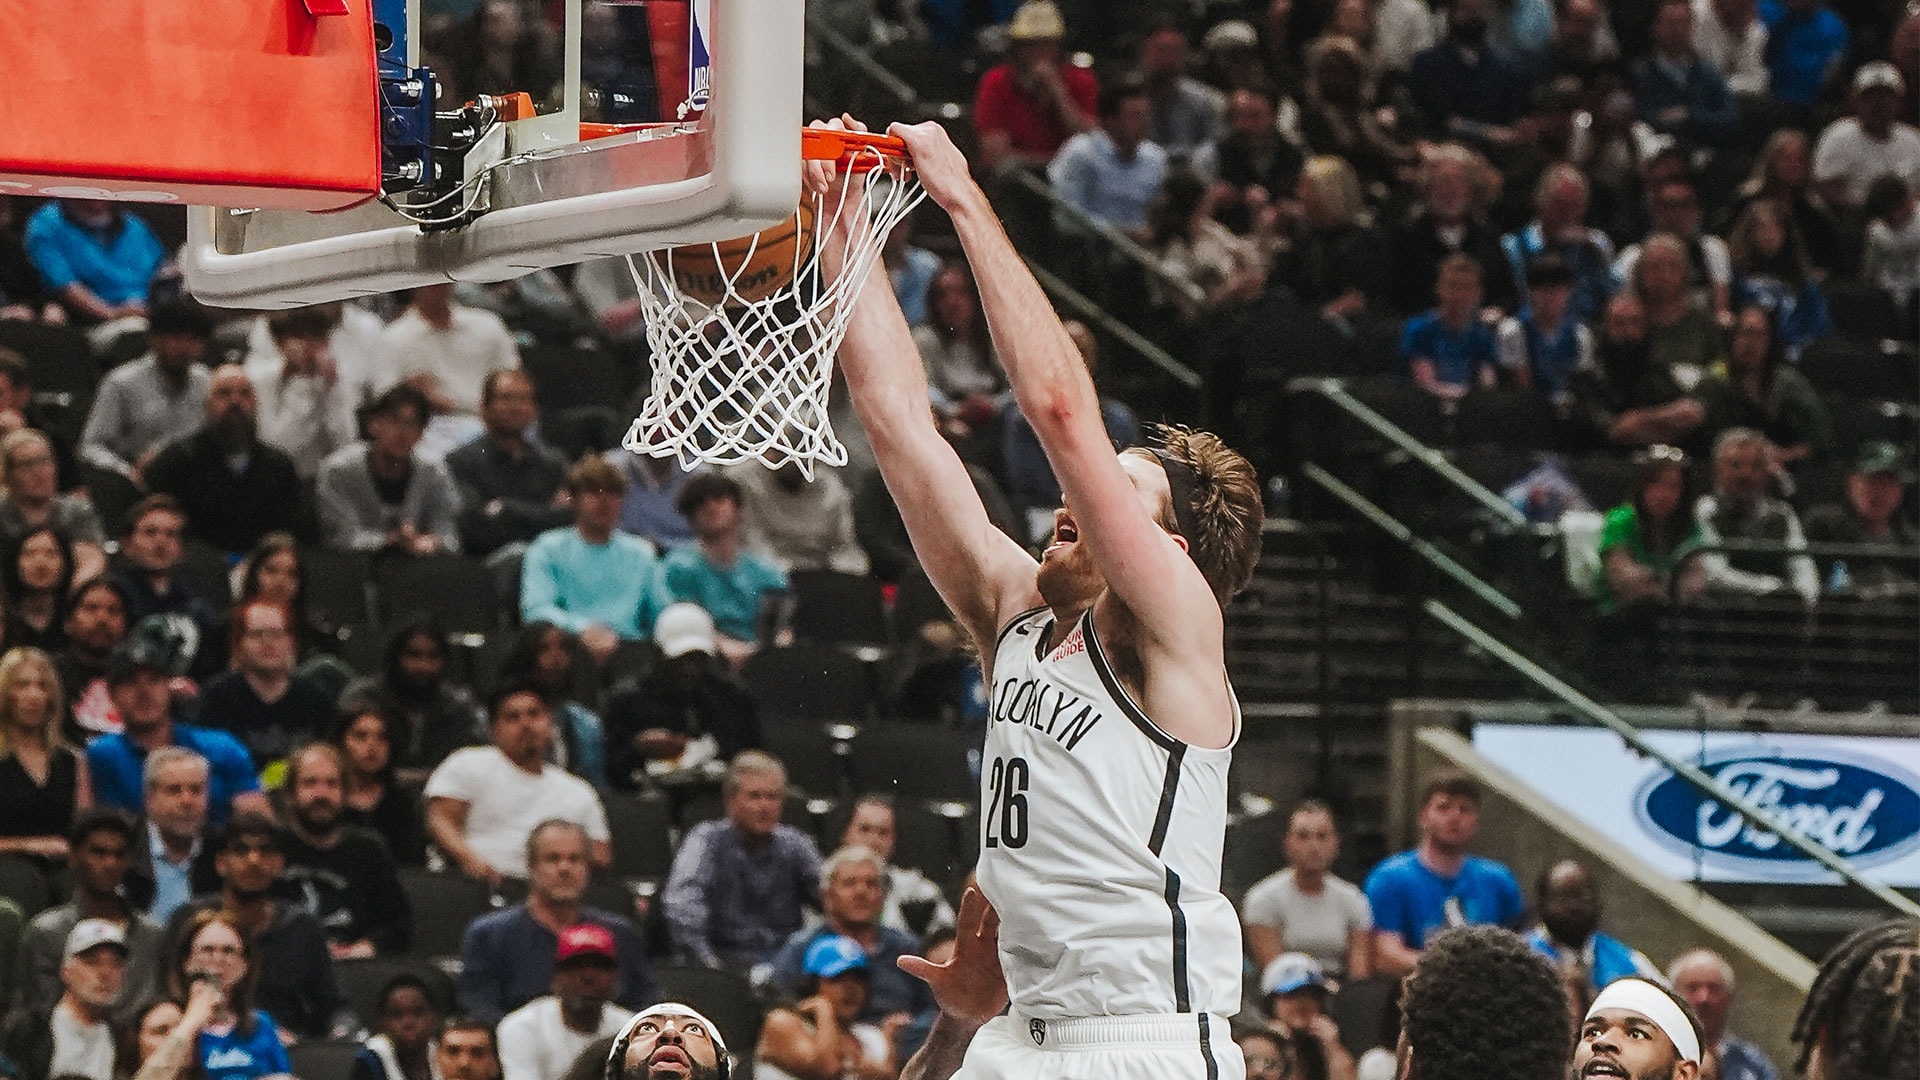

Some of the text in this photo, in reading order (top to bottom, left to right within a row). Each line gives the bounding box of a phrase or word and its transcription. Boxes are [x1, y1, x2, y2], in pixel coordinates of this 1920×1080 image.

[673, 264, 778, 294] Wilon
[1052, 640, 1085, 663] GUIDE
[986, 756, 1029, 849] 26
[1696, 761, 1885, 853] Ford
